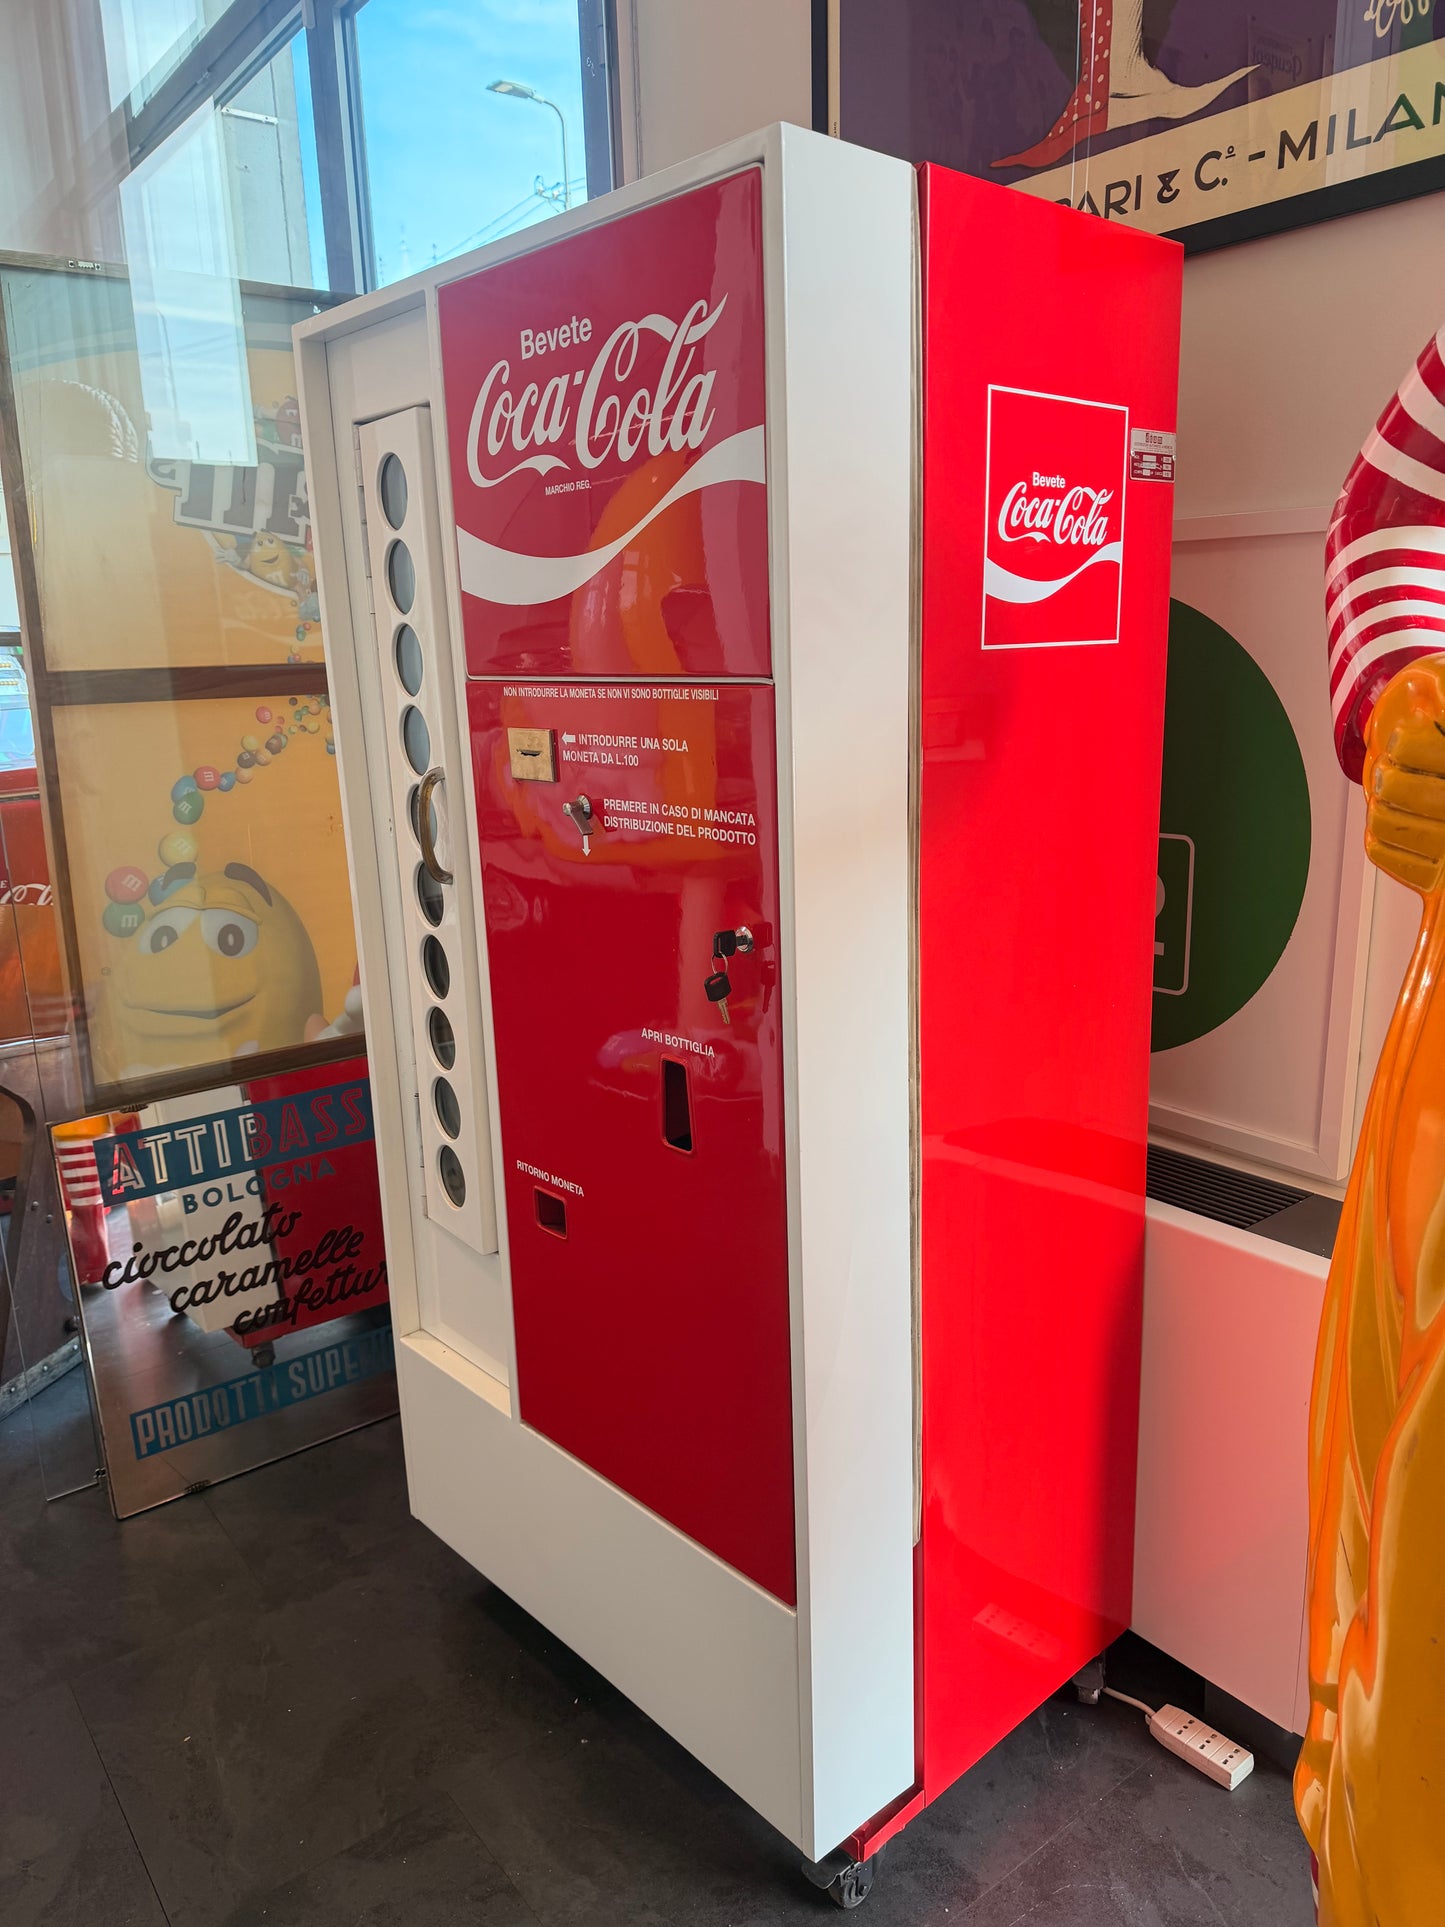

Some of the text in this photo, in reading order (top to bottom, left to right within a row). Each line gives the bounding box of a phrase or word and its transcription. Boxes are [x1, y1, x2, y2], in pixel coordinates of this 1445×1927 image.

[1054, 174, 1142, 220] ARI
[1156, 168, 1181, 204] &
[520, 315, 592, 360] Bevete
[466, 292, 728, 488] Coca-Cola
[545, 479, 592, 496] MARCHIO REG.
[1032, 471, 1066, 489] Bevete
[998, 481, 1114, 546] Coca-Cola
[503, 686, 719, 701] NON INTRODURRE LA MONETA SE NON VI SONO BOTTIGLIE VISIBILI
[562, 750, 639, 767] MONETA DA L.100
[578, 733, 689, 752] INTRODURRE UNA SOLA
[603, 798, 756, 826] PREMERE IN CASO DI MANCATA
[603, 815, 757, 846] DISTRIBUZIONE DEL PRODOTTO
[641, 1027, 715, 1058] APRI BOTTIGLIA
[182, 1158, 336, 1215] BOLOGNA
[516, 1159, 585, 1197] RITORNO MONETA
[102, 1201, 302, 1290] cioccolato
[170, 1225, 364, 1313] caramelle
[135, 1370, 279, 1455] PRODOTTI
